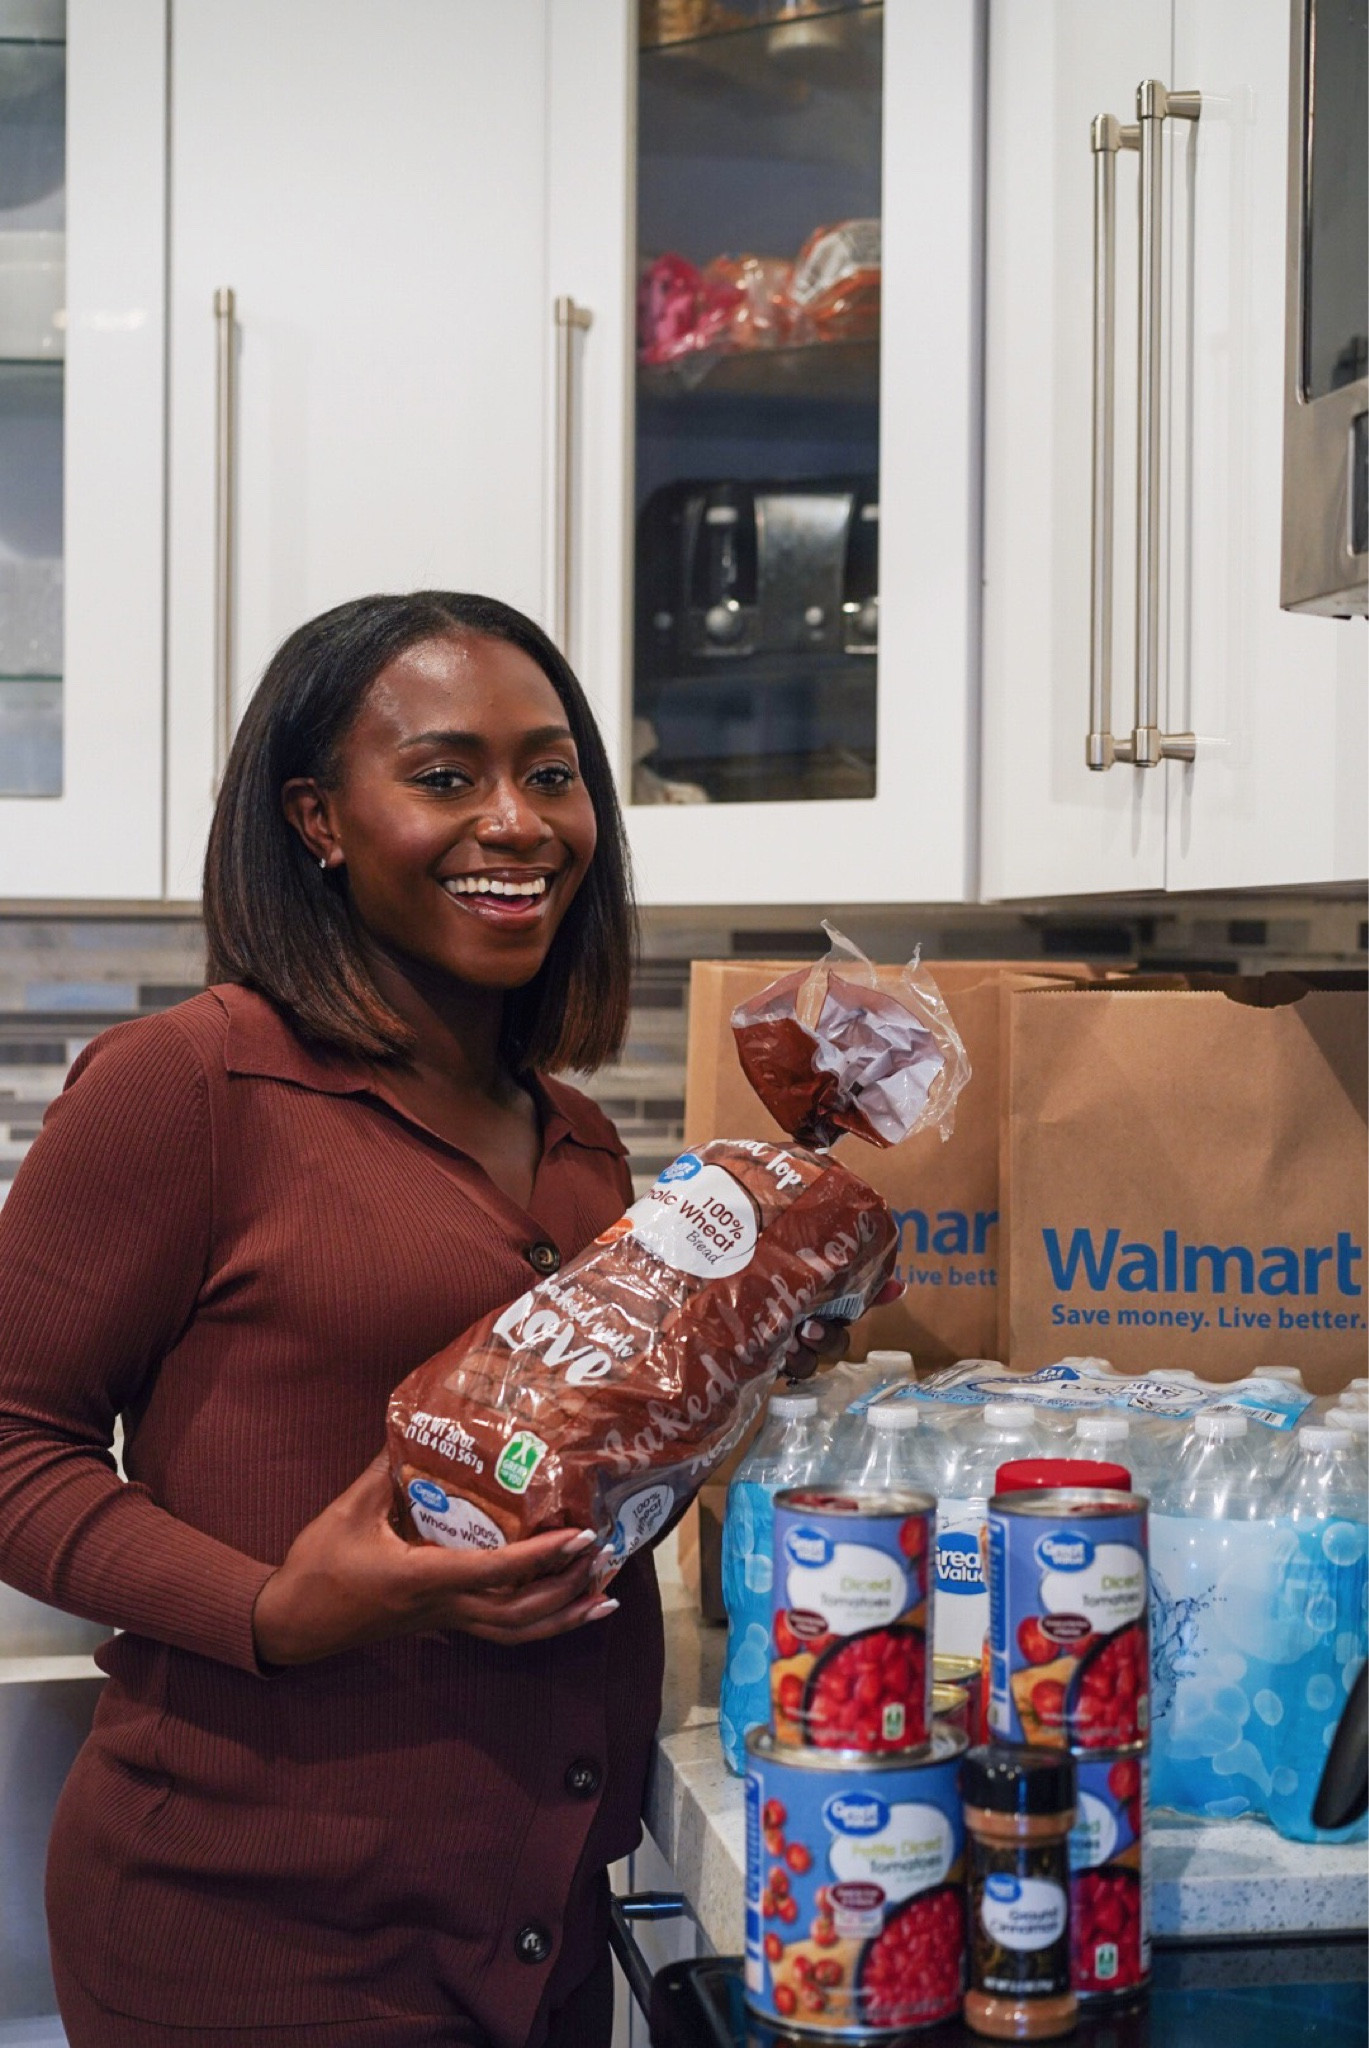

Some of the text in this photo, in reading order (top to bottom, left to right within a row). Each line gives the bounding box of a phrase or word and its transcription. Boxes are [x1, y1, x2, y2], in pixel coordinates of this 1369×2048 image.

[766, 1150, 801, 1190] Top
[679, 1199, 735, 1252] Wheat
[702, 1196, 745, 1241] 100%
[686, 1230, 725, 1266] Bread
[1042, 1228, 1362, 1296] Walmart
[949, 1265, 998, 1286] bett
[1052, 1303, 1367, 1333] Save money. Live better.
[417, 1428, 430, 1446] LB
[430, 1437, 438, 1450] 4
[633, 1492, 661, 1518] 100%
[419, 1511, 457, 1537] Whole
[469, 1520, 499, 1545] 100%
[936, 1547, 981, 1569] rea
